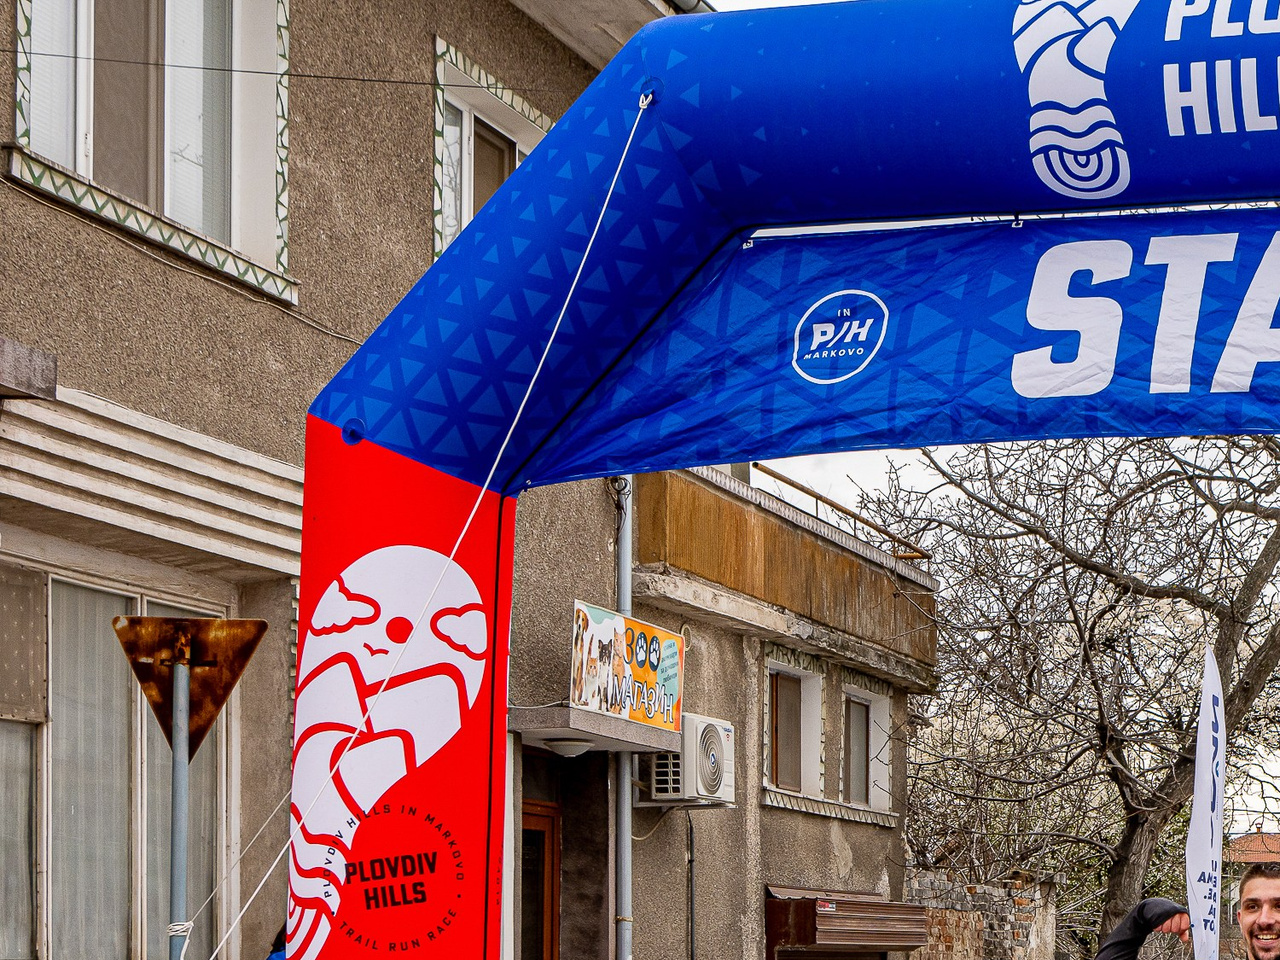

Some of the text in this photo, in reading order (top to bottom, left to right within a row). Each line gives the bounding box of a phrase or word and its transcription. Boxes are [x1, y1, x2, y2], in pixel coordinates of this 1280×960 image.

[837, 308, 851, 317] IN
[810, 318, 875, 351] P/H
[803, 347, 865, 360] MARKOVO
[612, 674, 674, 723] МАГАЗИН
[323, 829, 344, 899] PLOVDIV
[346, 804, 391, 829] HILLS
[400, 805, 418, 816] IN
[424, 813, 465, 881] MARKOVO
[344, 851, 438, 885] PLOVDIV
[364, 881, 428, 911] HILLS
[338, 908, 457, 952] TRAIL RUN RACE
